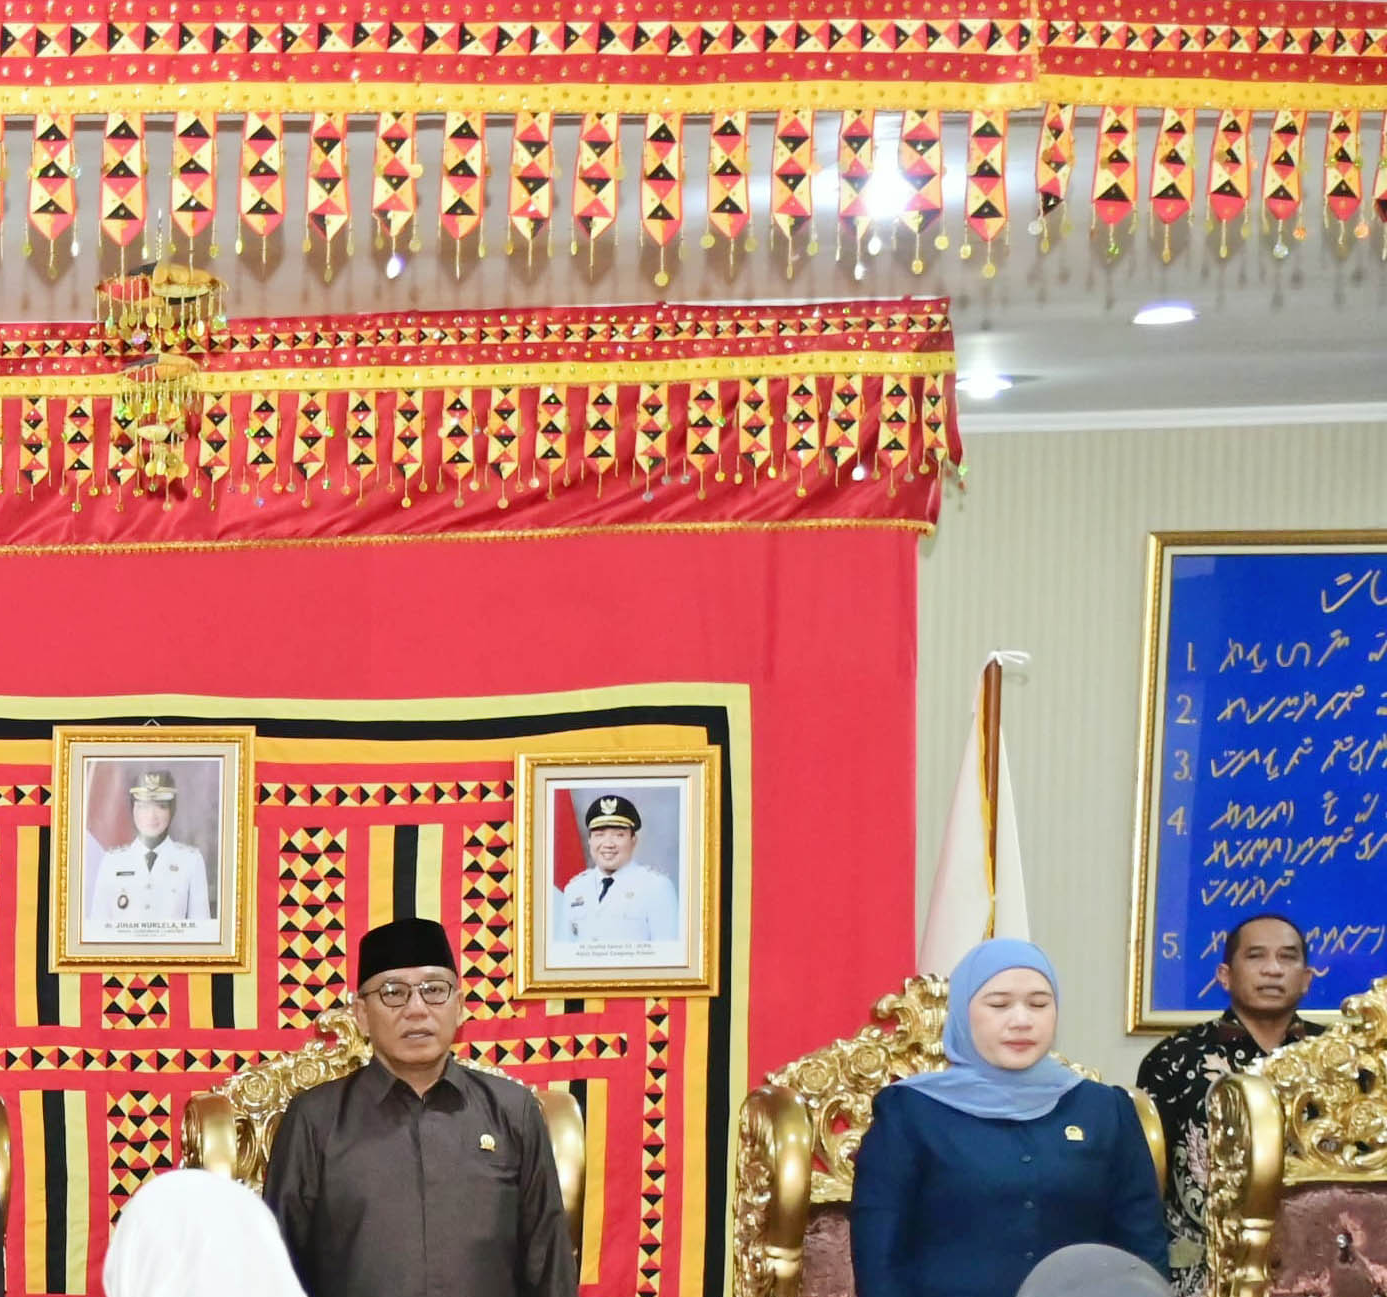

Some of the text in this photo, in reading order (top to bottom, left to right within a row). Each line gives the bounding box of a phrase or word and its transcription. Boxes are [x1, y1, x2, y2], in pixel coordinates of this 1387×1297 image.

[1174, 693, 1198, 725] 2.
[1173, 748, 1193, 782] 3.
[1166, 805, 1188, 836] 4.
[1162, 932, 1182, 961] 5.
